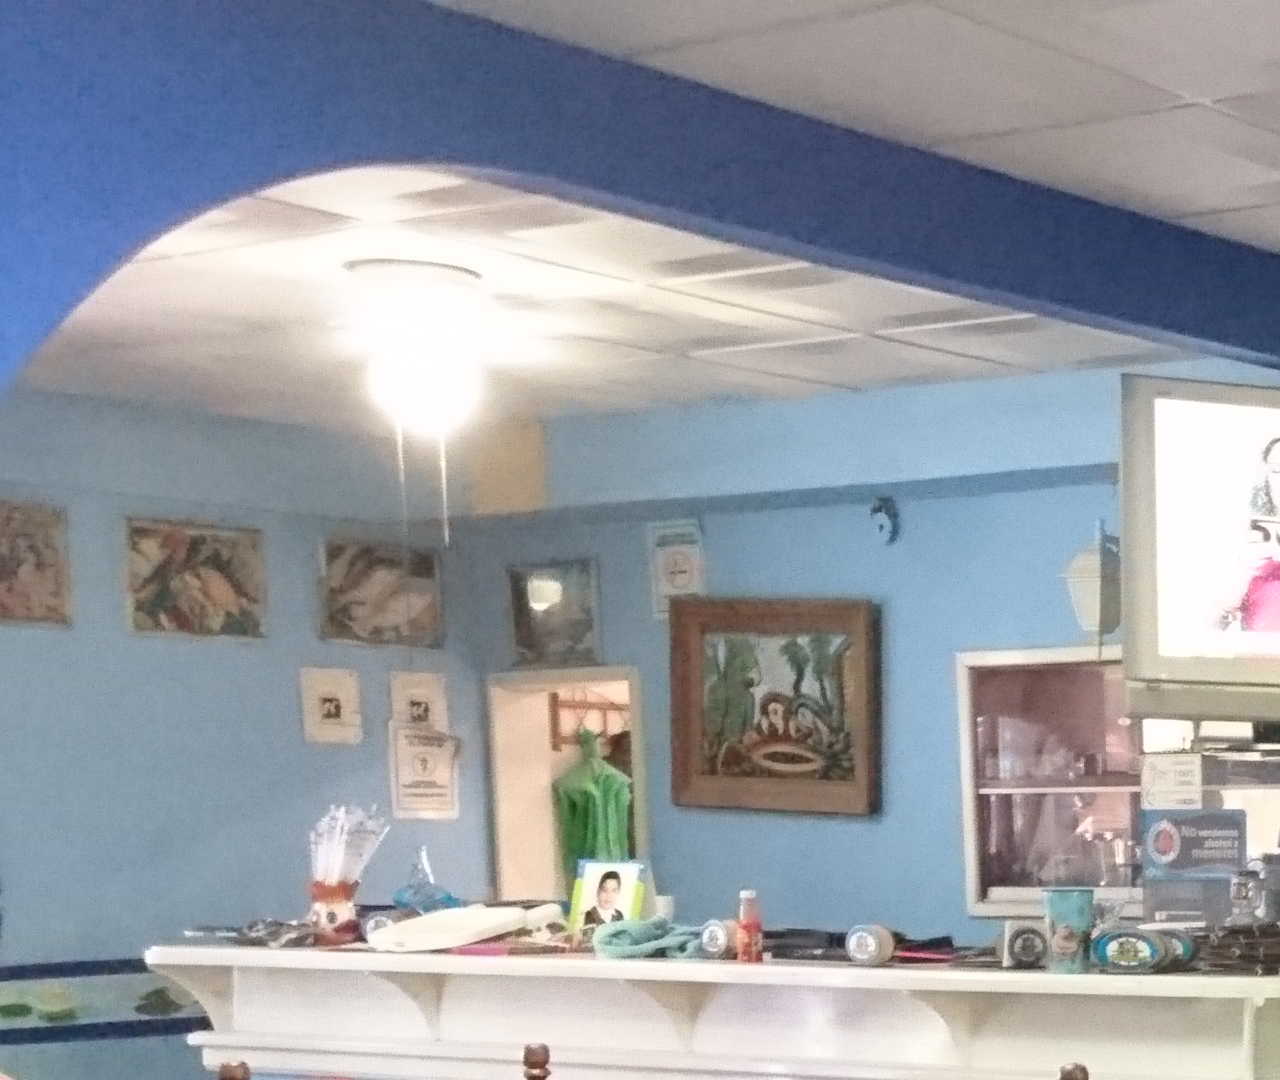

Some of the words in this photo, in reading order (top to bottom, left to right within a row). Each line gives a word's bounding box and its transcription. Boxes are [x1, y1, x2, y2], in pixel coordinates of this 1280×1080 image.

[1198, 829, 1238, 837] vendemos
[1203, 839, 1233, 848] alcohol
[1191, 849, 1239, 859] menores
